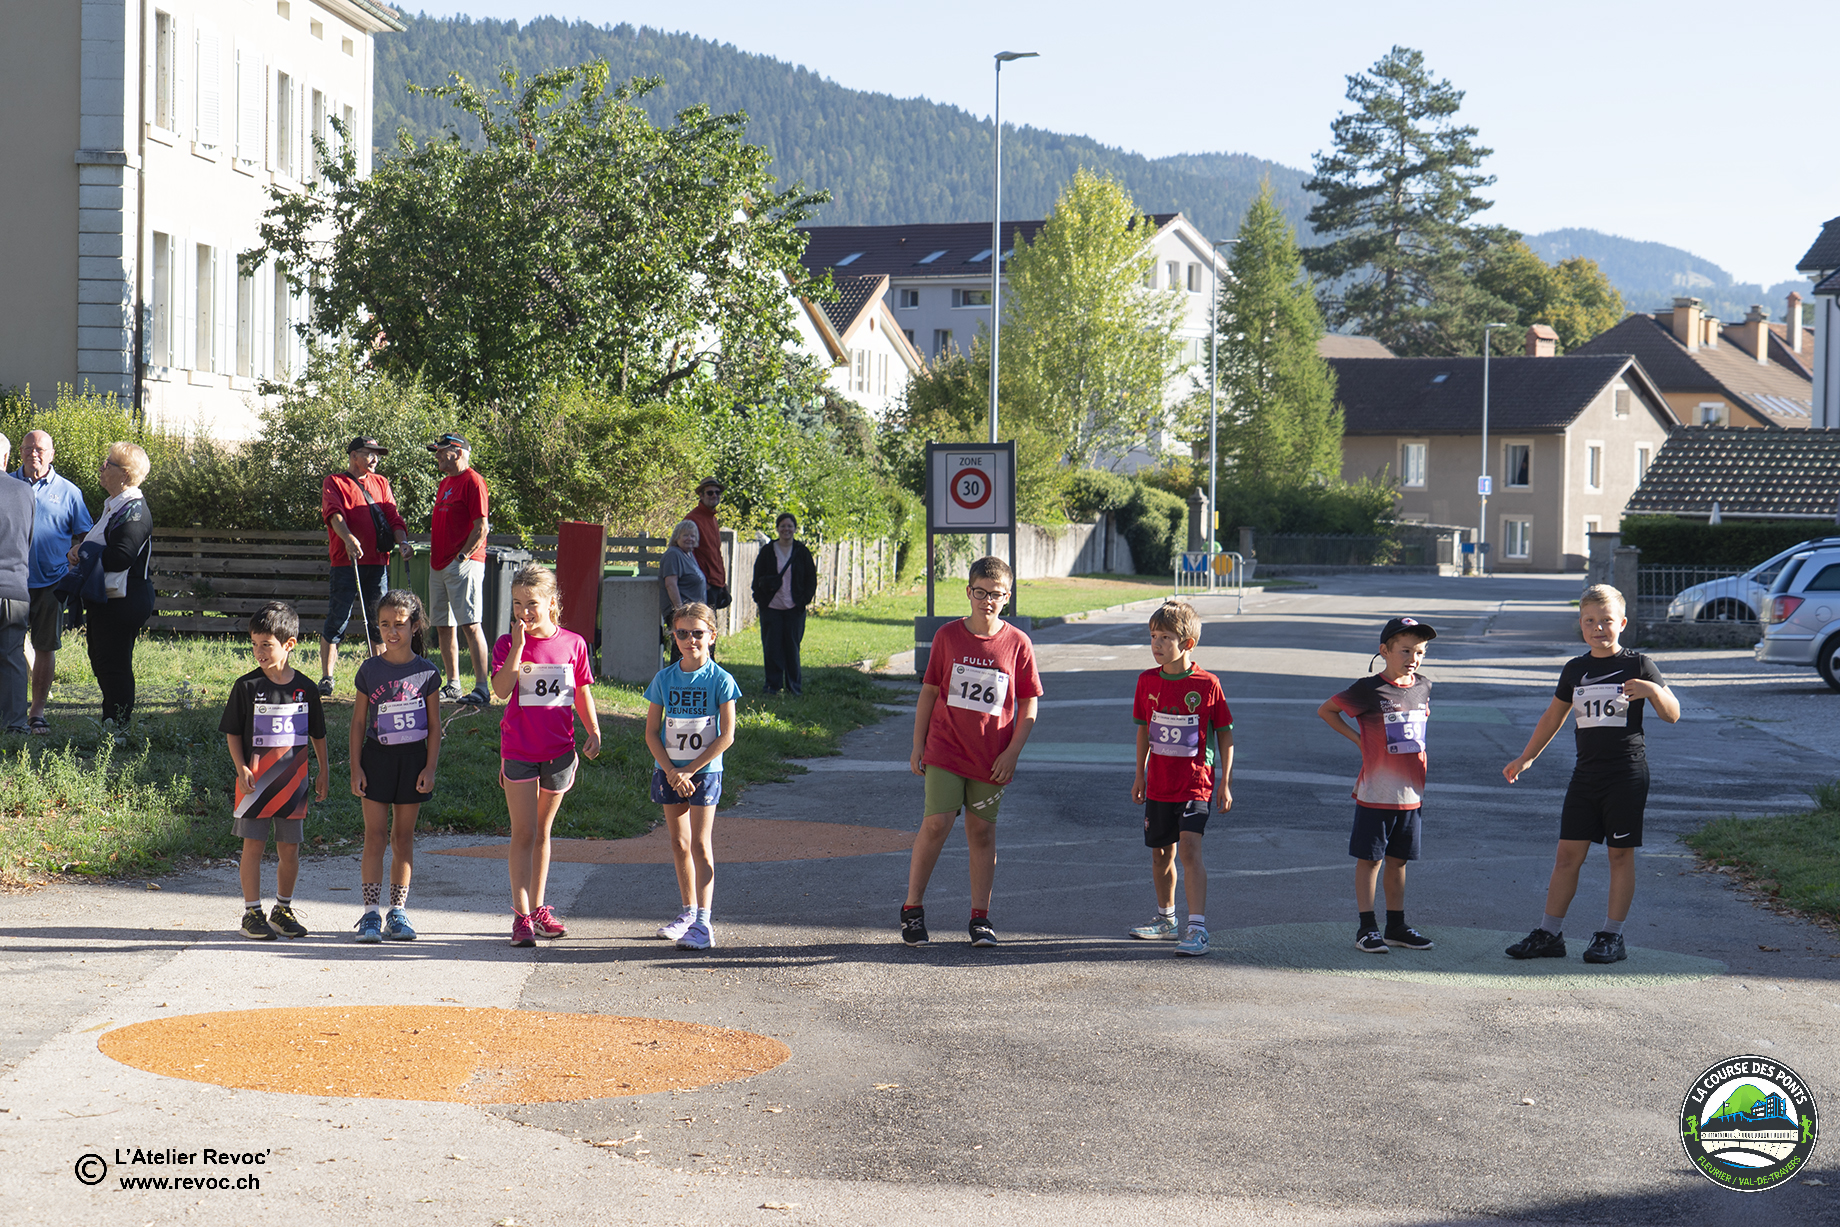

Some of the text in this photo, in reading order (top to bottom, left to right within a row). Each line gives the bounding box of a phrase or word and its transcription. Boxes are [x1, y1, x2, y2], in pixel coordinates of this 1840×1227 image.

[959, 457, 982, 466] ZONE
[963, 481, 979, 496] 30
[963, 656, 994, 666] FULLY
[369, 684, 386, 704] FREE
[388, 680, 399, 689] TO
[535, 679, 560, 697] 84
[960, 681, 995, 704] 126
[669, 690, 707, 707] DEFI
[668, 707, 707, 715] JEUNESSE
[1583, 699, 1615, 718] 116
[272, 716, 294, 733] 56
[393, 712, 416, 730] 55
[1159, 726, 1182, 744] 39
[1403, 723, 1422, 740] 59
[676, 733, 702, 751] 70
